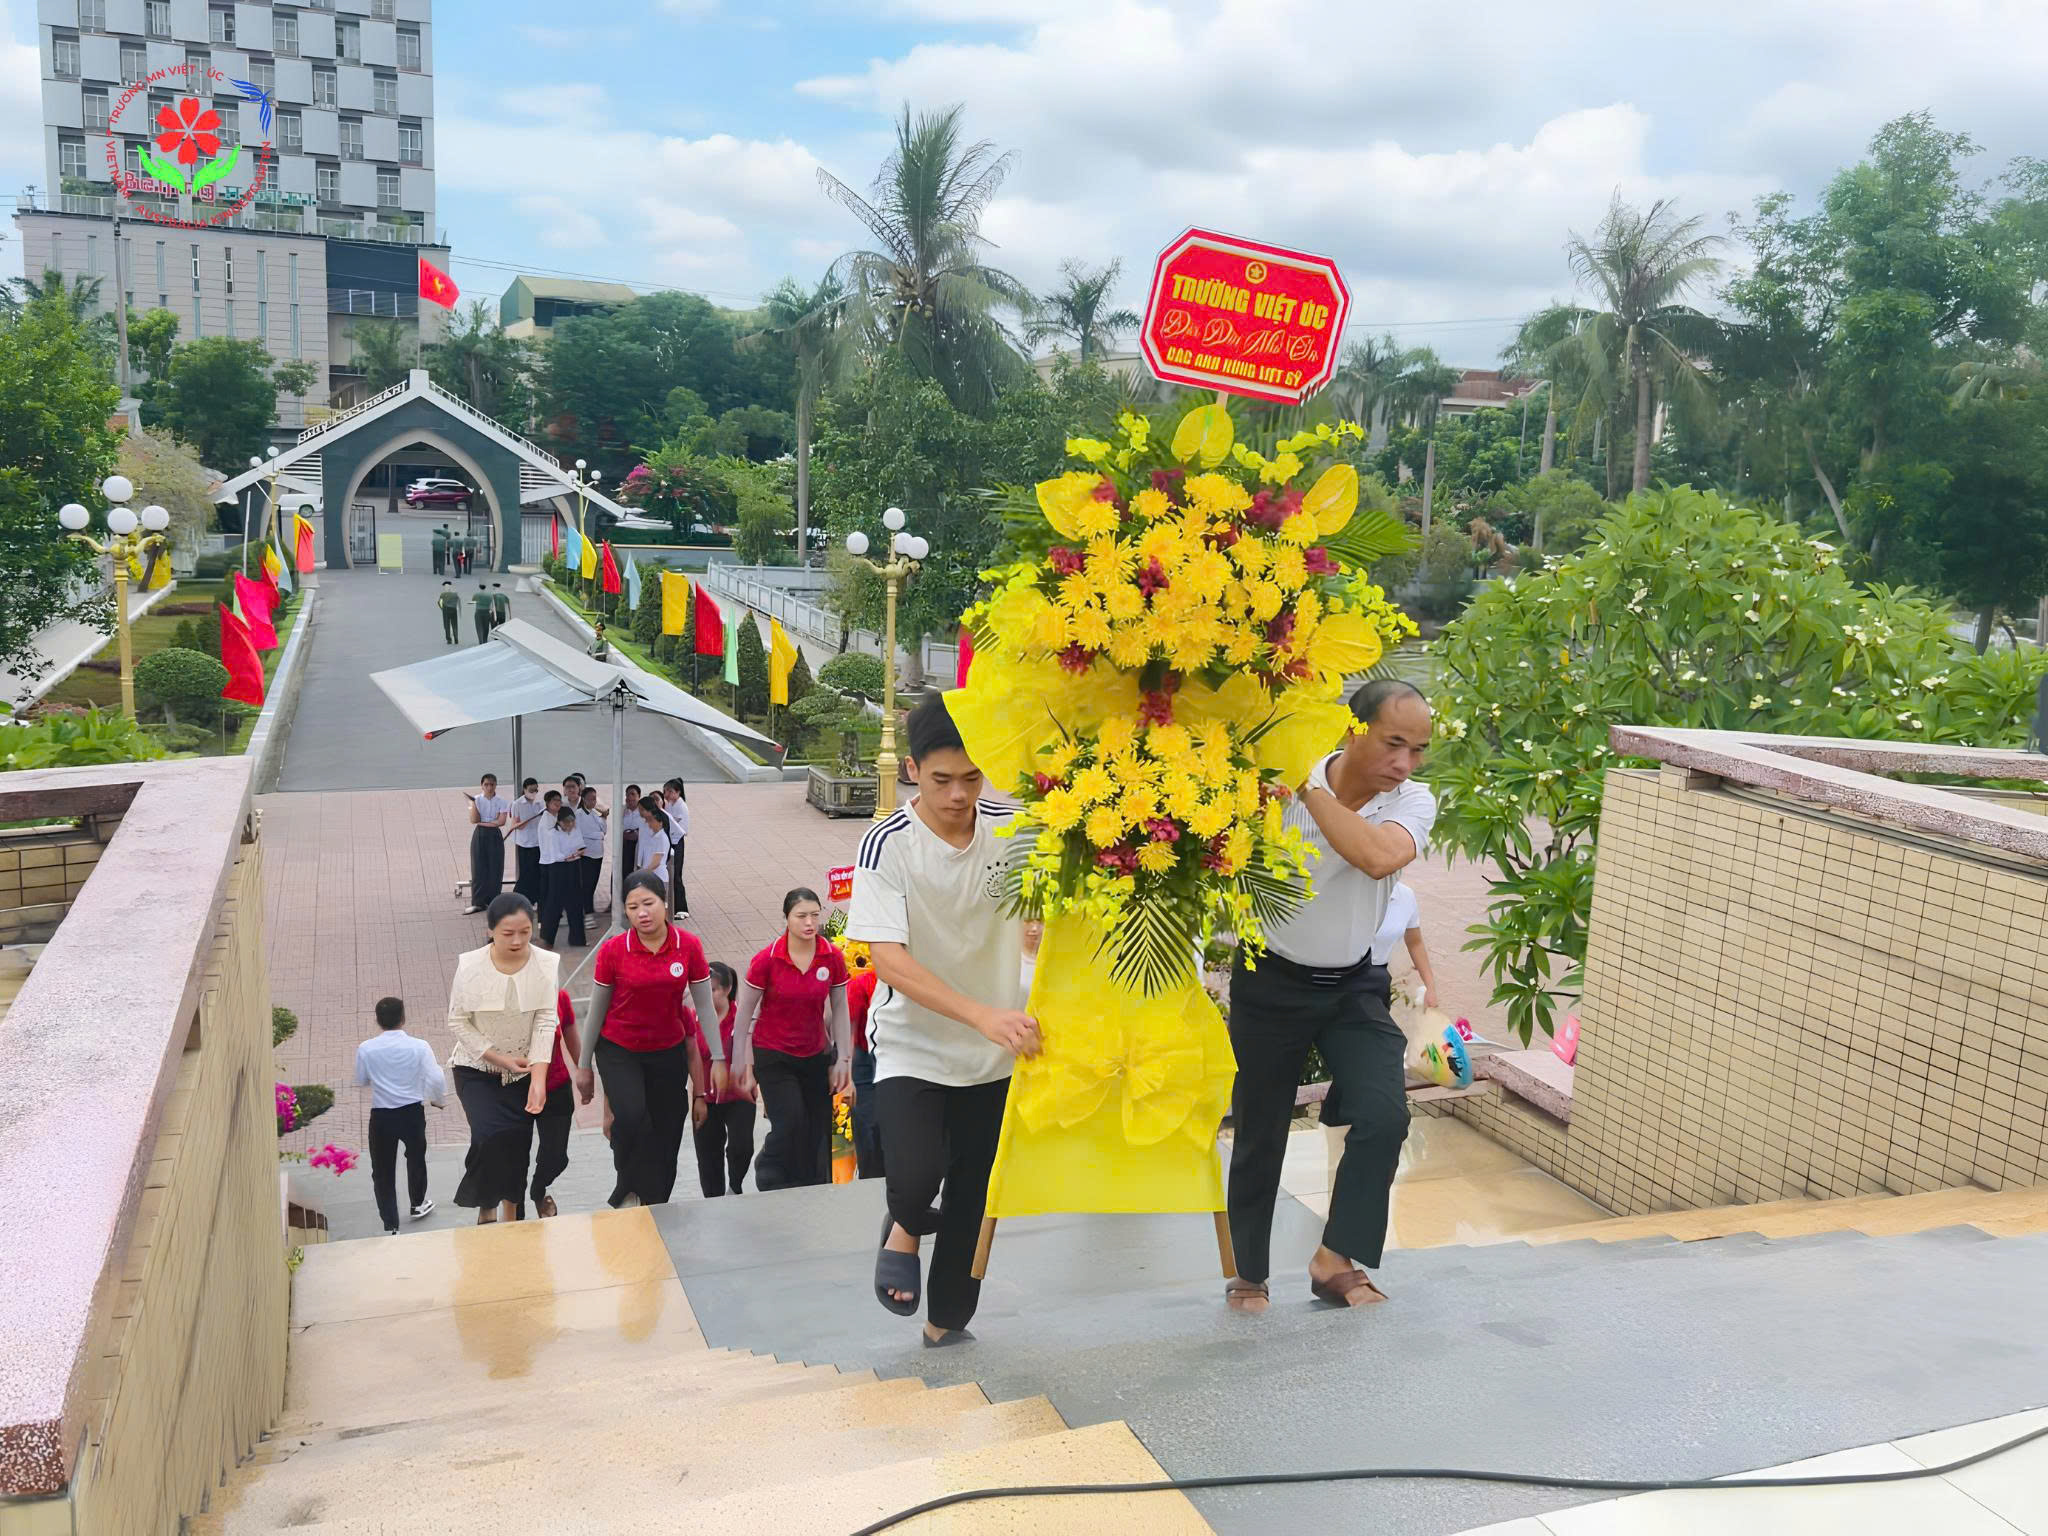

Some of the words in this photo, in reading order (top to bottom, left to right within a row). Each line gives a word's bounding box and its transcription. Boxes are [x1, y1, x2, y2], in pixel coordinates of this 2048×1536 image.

[1172, 274, 1250, 313] TRƯỜNG
[1254, 293, 1297, 325] VIỆT
[1299, 300, 1328, 330] ÚC
